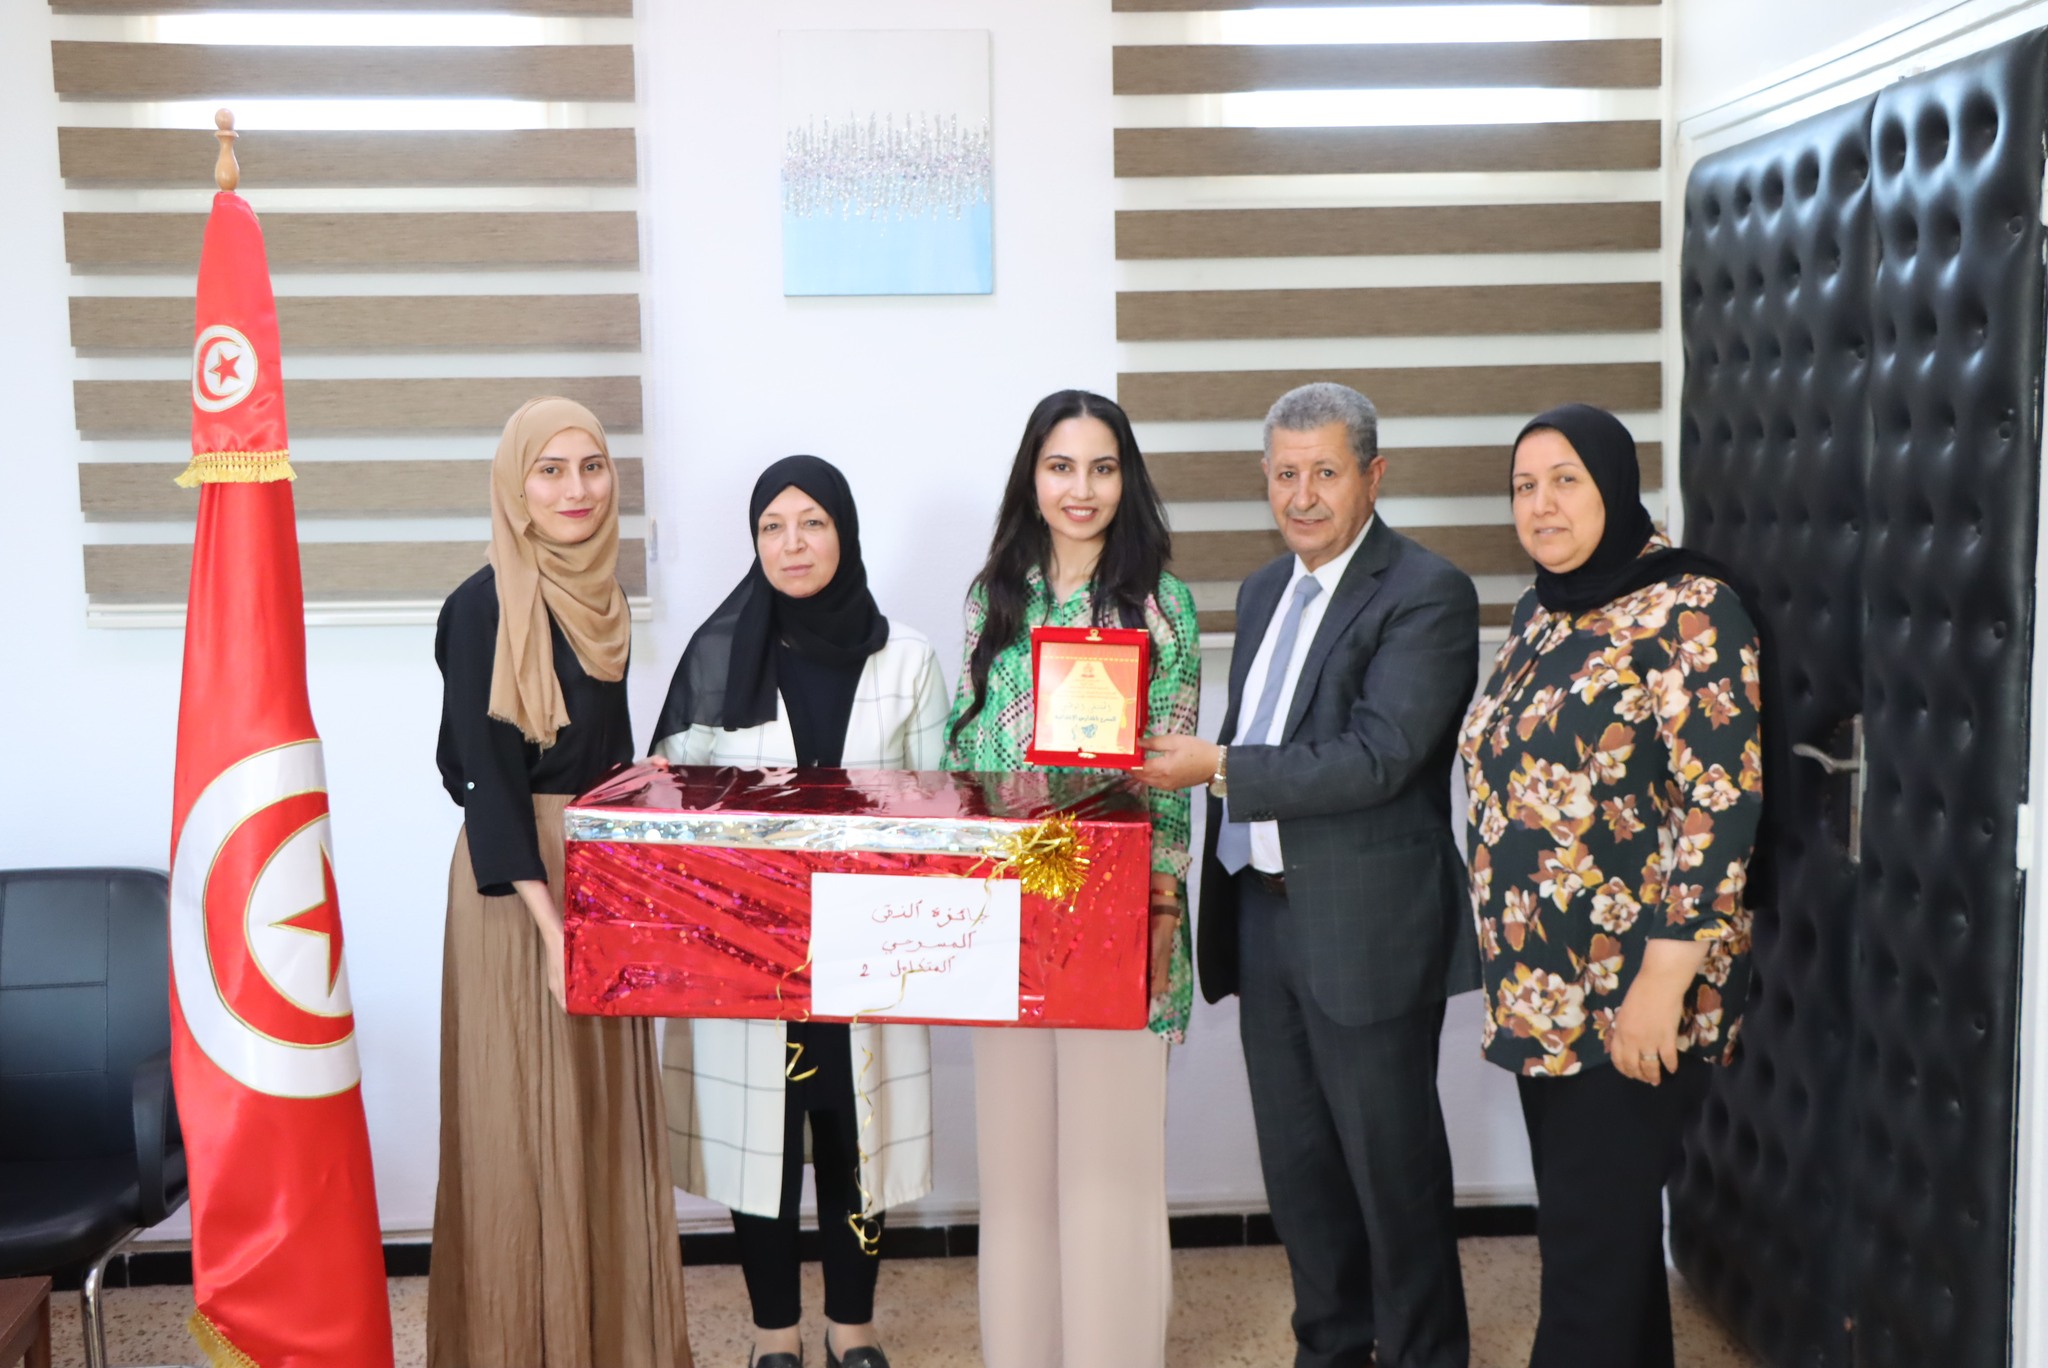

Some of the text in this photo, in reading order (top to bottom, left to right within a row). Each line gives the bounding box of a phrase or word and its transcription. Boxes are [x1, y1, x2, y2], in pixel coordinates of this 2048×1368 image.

[931, 906, 990, 928] جائزة
[881, 930, 977, 955] المسرحي
[859, 955, 956, 977] المتكامل 2
